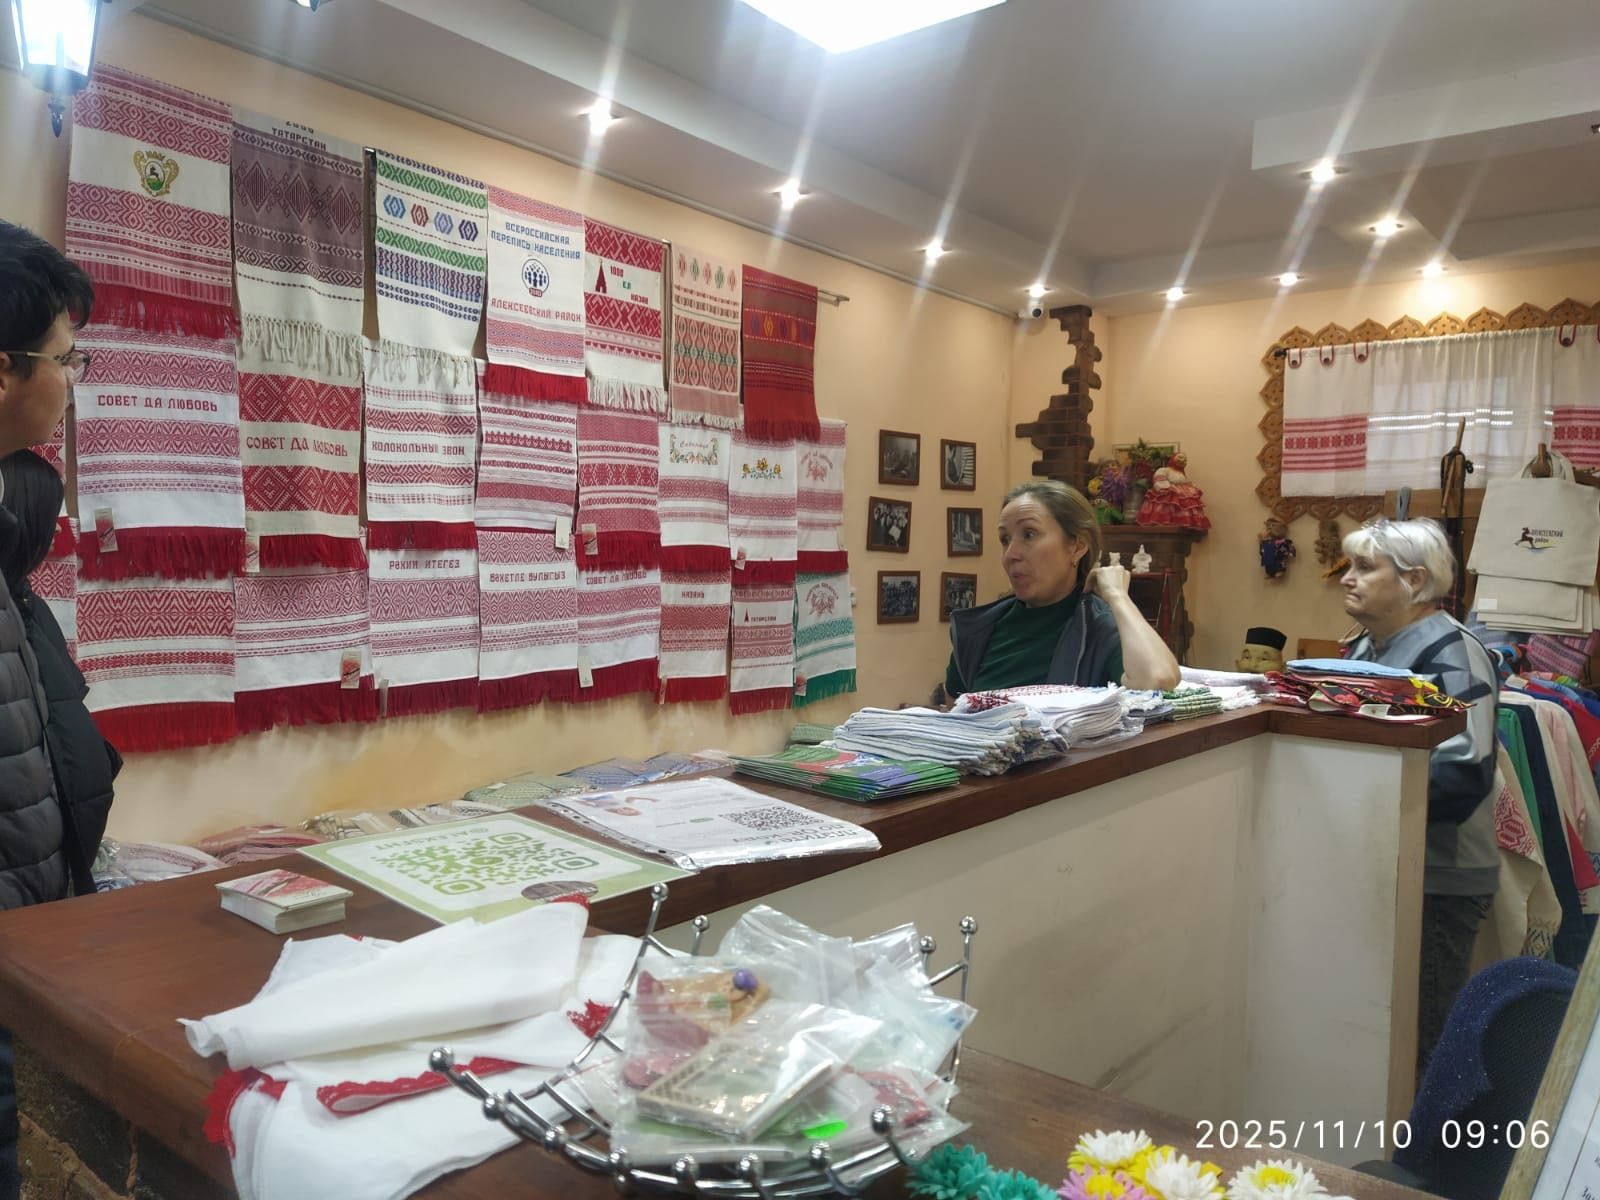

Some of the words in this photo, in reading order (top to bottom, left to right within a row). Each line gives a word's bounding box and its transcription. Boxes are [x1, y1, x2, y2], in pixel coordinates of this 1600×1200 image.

[272, 127, 326, 150] ТАТАРСТАН
[505, 222, 570, 245] ВСЕРОССИЙСКАЯ
[491, 230, 531, 250] ПЕРЕПИСЬ
[534, 243, 581, 260] НАСЕЛЕНИЯ
[491, 298, 552, 319] АЛЕКСЕЕВСКИЙ
[555, 311, 581, 322] РАЙОН
[97, 395, 138, 407] СОВЕТ
[144, 397, 163, 408] ДА
[168, 398, 218, 412] ЛЮБОВЬ
[246, 436, 285, 450] СОВЕТ
[290, 437, 309, 451] ДА
[313, 439, 348, 456] ЛЮБОВЬ
[442, 446, 465, 455] ЗВОН
[424, 559, 460, 569] ИТЕГЕЗ
